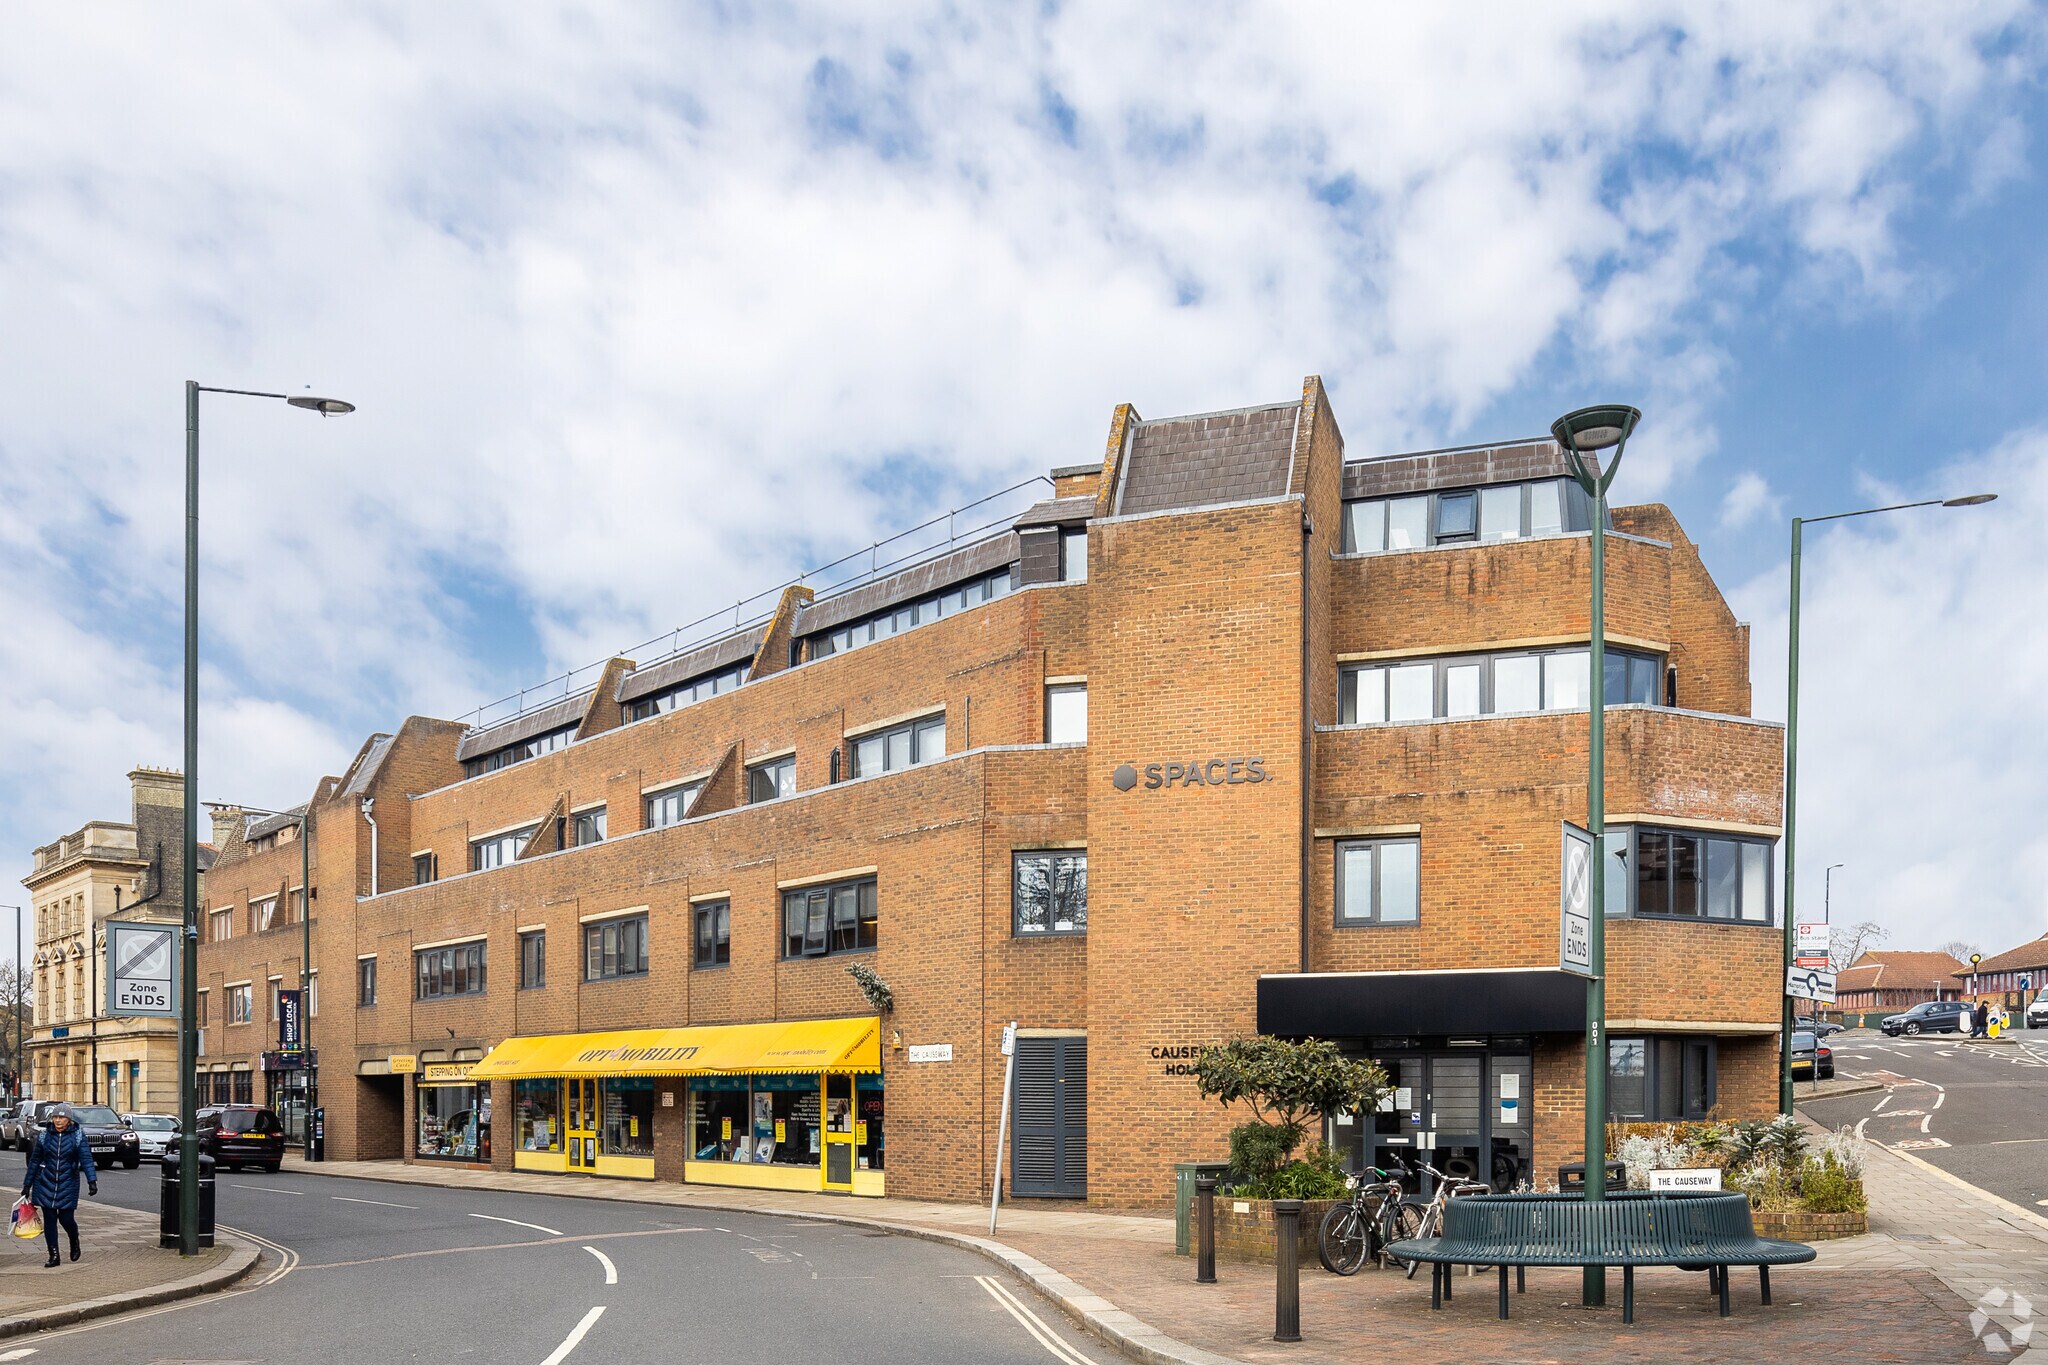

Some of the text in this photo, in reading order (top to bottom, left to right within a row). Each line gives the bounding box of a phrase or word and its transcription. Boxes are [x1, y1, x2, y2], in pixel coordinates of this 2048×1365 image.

[1571, 921, 1584, 936] Zone
[1567, 938, 1587, 957] ENDS
[129, 983, 157, 992] Zone
[121, 994, 165, 1006] ENDS
[911, 1050, 949, 1059] THE CAUSEWAY
[430, 1066, 453, 1077] STEPPING
[454, 1066, 462, 1076] ON
[1658, 1176, 1713, 1186] THE CAUSEWAY
